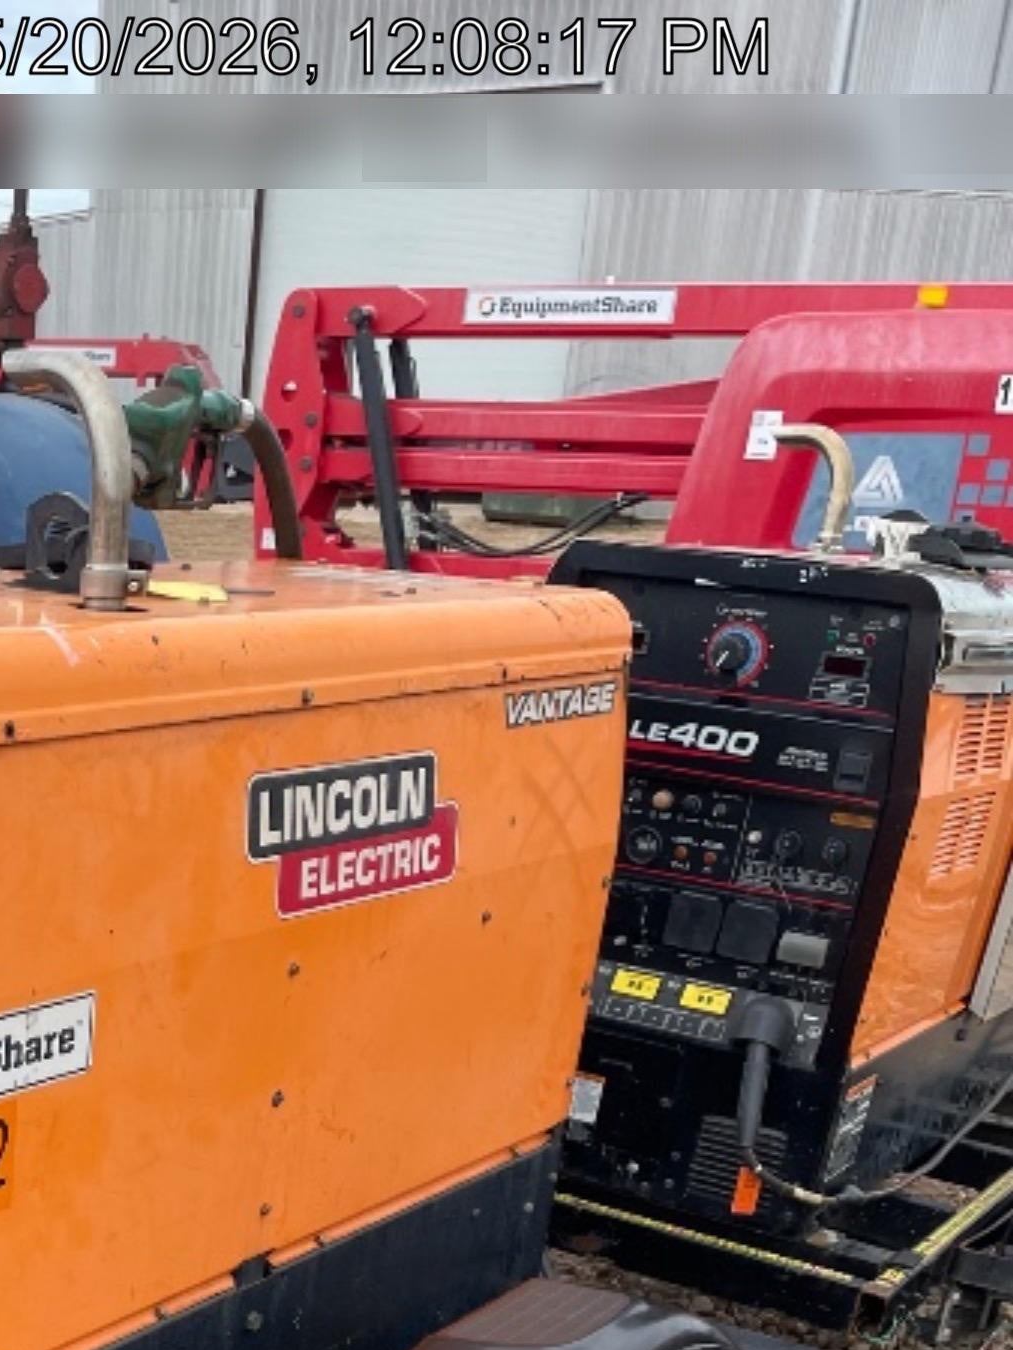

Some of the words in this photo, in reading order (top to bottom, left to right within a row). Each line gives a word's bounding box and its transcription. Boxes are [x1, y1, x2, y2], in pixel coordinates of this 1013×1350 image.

[499, 296, 658, 318] EquipmentShare
[506, 683, 618, 727] VANTAGE
[629, 719, 760, 758] LE400
[259, 767, 427, 847] LINCOLN
[300, 833, 441, 899] ELECTRIC
